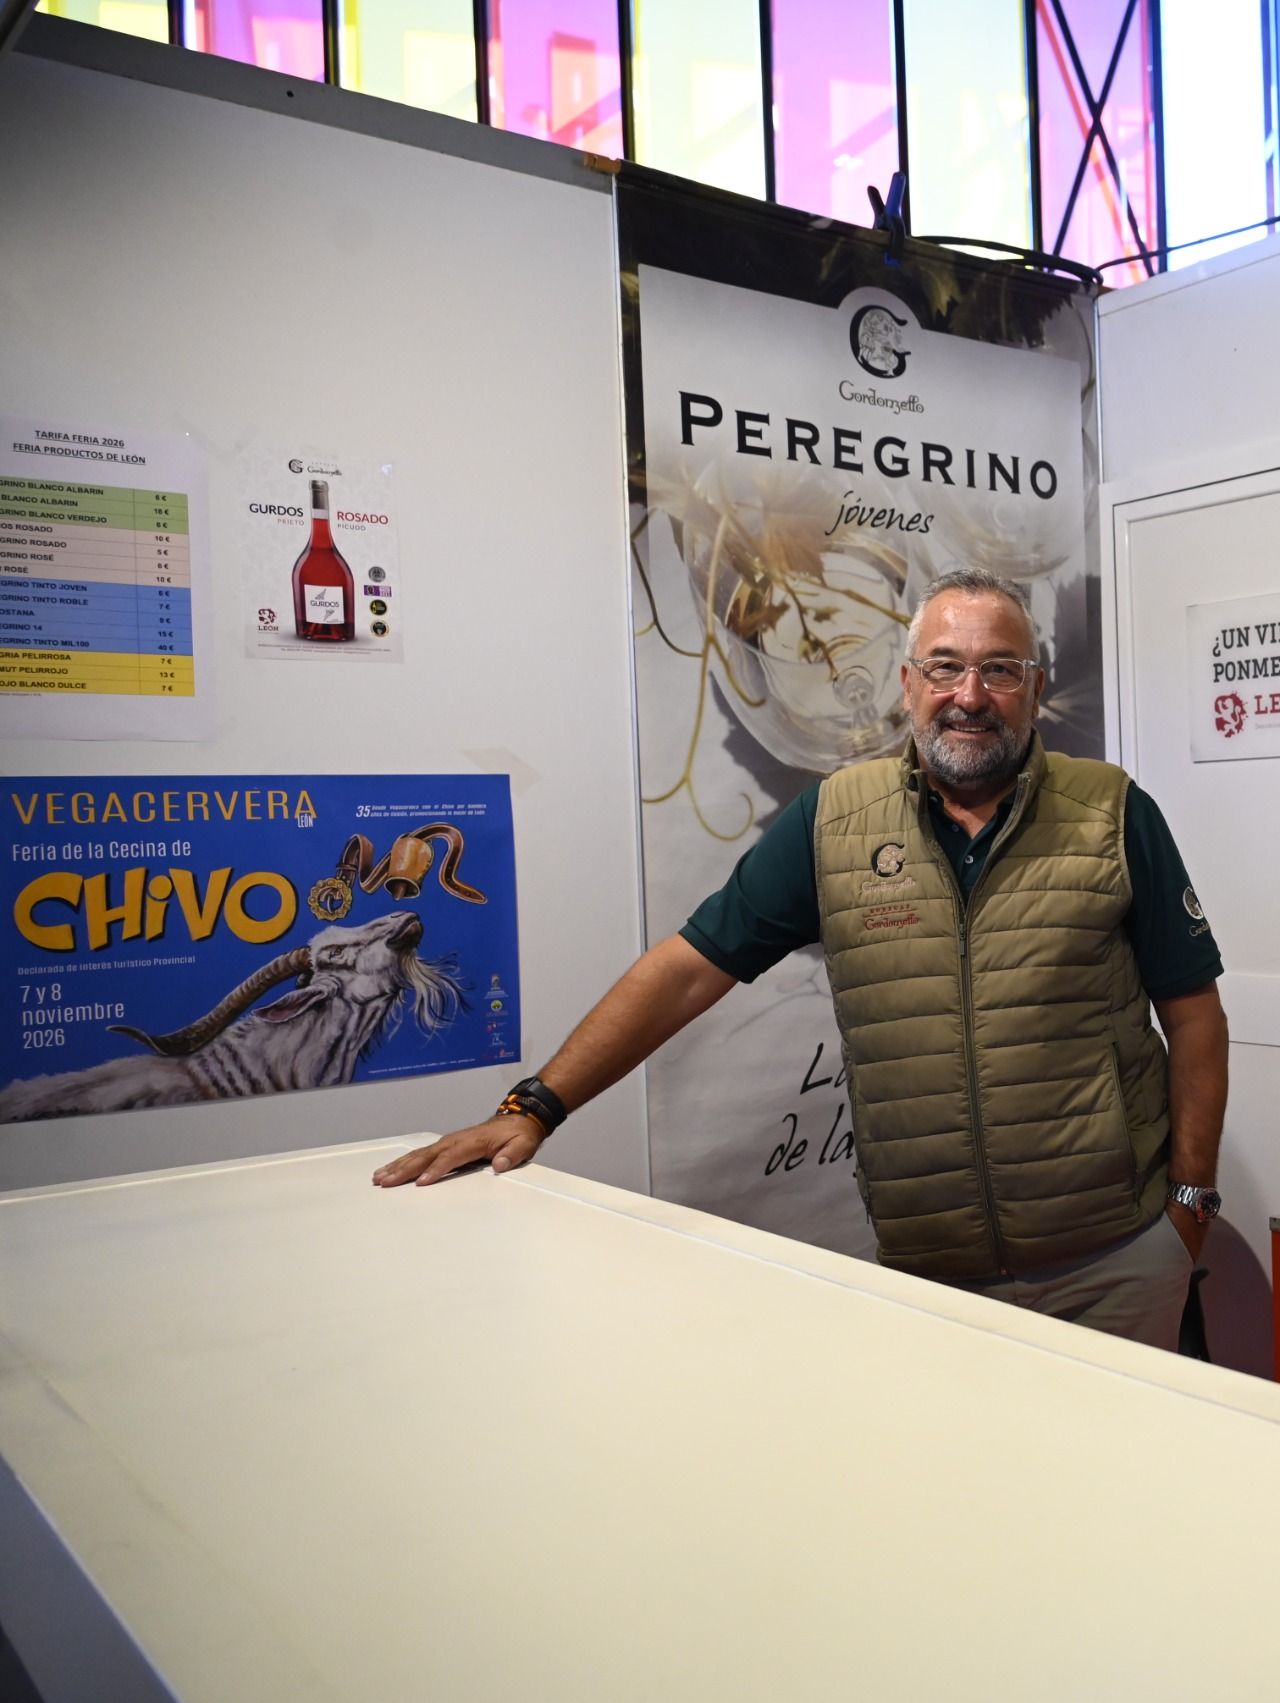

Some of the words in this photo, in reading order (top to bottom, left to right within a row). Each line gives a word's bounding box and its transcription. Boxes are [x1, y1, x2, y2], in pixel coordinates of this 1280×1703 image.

[35, 430, 70, 441] TARIFA
[72, 434, 100, 445] FERIA
[102, 438, 125, 447] 2026
[678, 390, 1058, 500] PEREGRINO
[13, 443, 41, 453] FERIA
[44, 446, 104, 460] PRODUCTOS
[106, 453, 119, 461] DE
[121, 454, 146, 464] LEÓN
[28, 482, 64, 492] BLANCO
[66, 486, 104, 495] ALBARIN
[1, 494, 38, 504] BLANCO
[40, 498, 78, 507] ALBARIN
[29, 511, 65, 520] BLANCO
[67, 514, 107, 523] VERDEJO
[249, 503, 304, 518] GURDOS
[825, 489, 935, 536] jóvenes
[277, 518, 305, 526] PRIETO
[337, 511, 389, 525] ROSADO
[15, 524, 53, 533] ROSADO
[337, 523, 366, 531] PICUDO
[29, 539, 67, 548] ROSADO
[30, 552, 54, 561] ROSÉ
[4, 565, 29, 574] ROSÉ
[31, 581, 57, 590] TINTO
[58, 583, 87, 592] JOVEN
[32, 596, 57, 605] TINTO
[59, 597, 89, 606] ROBLE
[33, 638, 59, 646] TINTO
[1212, 626, 1250, 657] ¿UN
[22, 653, 72, 661] PELIRROSA
[19, 667, 69, 675] PELIRROJO
[19, 681, 56, 689] BLANCO
[57, 682, 87, 690] DULCE
[12, 790, 317, 825] VEGACERVERA
[356, 805, 371, 818] 35
[298, 813, 314, 828] LEÓN
[13, 843, 56, 862] Feria
[62, 843, 83, 860] de
[88, 841, 104, 859] la
[109, 840, 167, 859] Cecina
[172, 840, 192, 857] de
[18, 965, 65, 975] Declarada
[66, 964, 77, 972] de
[153, 956, 196, 967] Provincial
[20, 985, 31, 1003] 7
[35, 987, 47, 1005] y
[51, 983, 62, 1001] 8
[22, 1002, 125, 1026] noviembre
[22, 1028, 65, 1049] 2026
[765, 1113, 809, 1176] de
[818, 1103, 855, 1165] la
